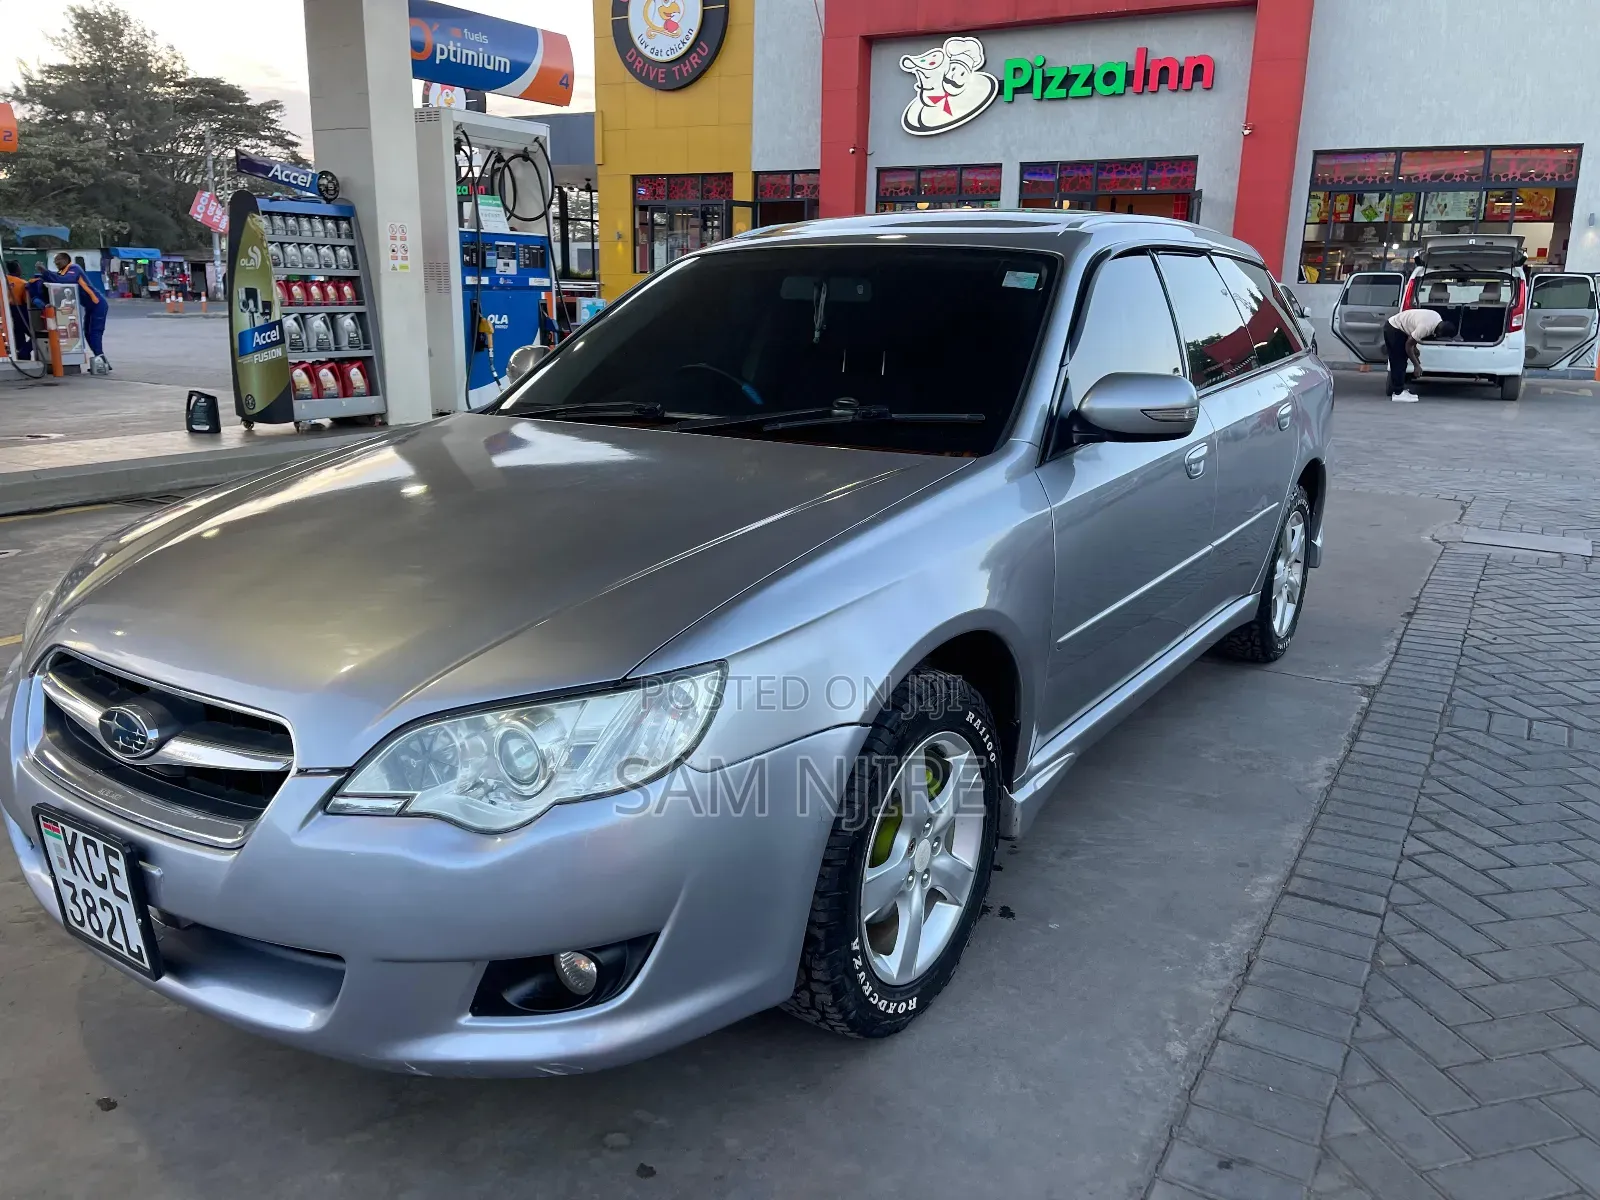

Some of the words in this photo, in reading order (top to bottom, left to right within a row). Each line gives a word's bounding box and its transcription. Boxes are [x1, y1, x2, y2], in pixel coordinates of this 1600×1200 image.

[463, 28, 489, 44] fuels
[637, 33, 649, 50] luv
[649, 46, 663, 57] dat
[665, 27, 694, 57] chicken
[625, 47, 667, 83] DRIVE
[672, 40, 710, 81] THRU
[558, 73, 570, 90] 4
[3, 130, 13, 142] 2
[267, 163, 313, 188] Accel
[240, 258, 256, 268] OLA
[487, 314, 509, 324] OLA
[253, 325, 281, 348] Accel
[253, 347, 283, 365] FUSION
[59, 824, 130, 904] KCE
[61, 877, 147, 966] 382L
